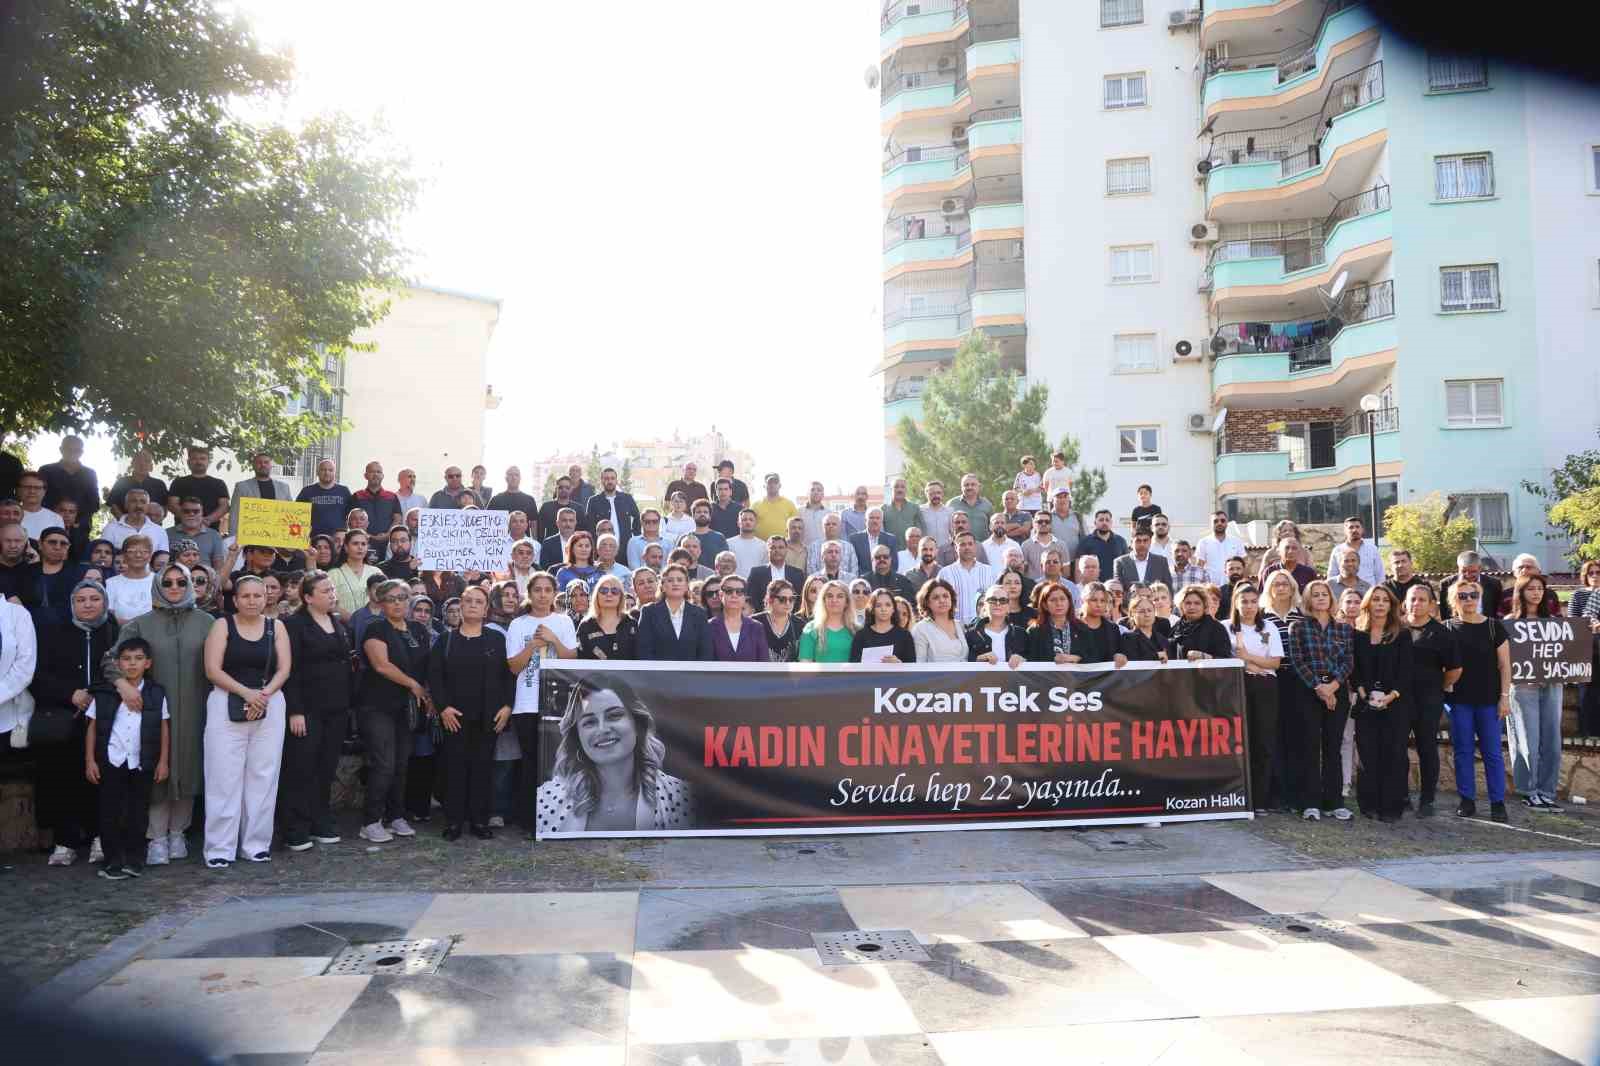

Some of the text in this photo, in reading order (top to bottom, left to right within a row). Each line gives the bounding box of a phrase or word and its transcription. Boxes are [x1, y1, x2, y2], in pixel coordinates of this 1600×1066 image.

[1513, 621, 1574, 643] SEVDA
[1532, 642, 1563, 658] HEP
[1512, 661, 1536, 679] 22
[874, 686, 1103, 713] Kozan Tek Ses
[703, 716, 1243, 767] KADIN CİNAYETLERİNE HAYIR!
[830, 769, 1141, 811] Sevda hep 22 yaşında...
[1165, 794, 1246, 810] Kozan Halkı
